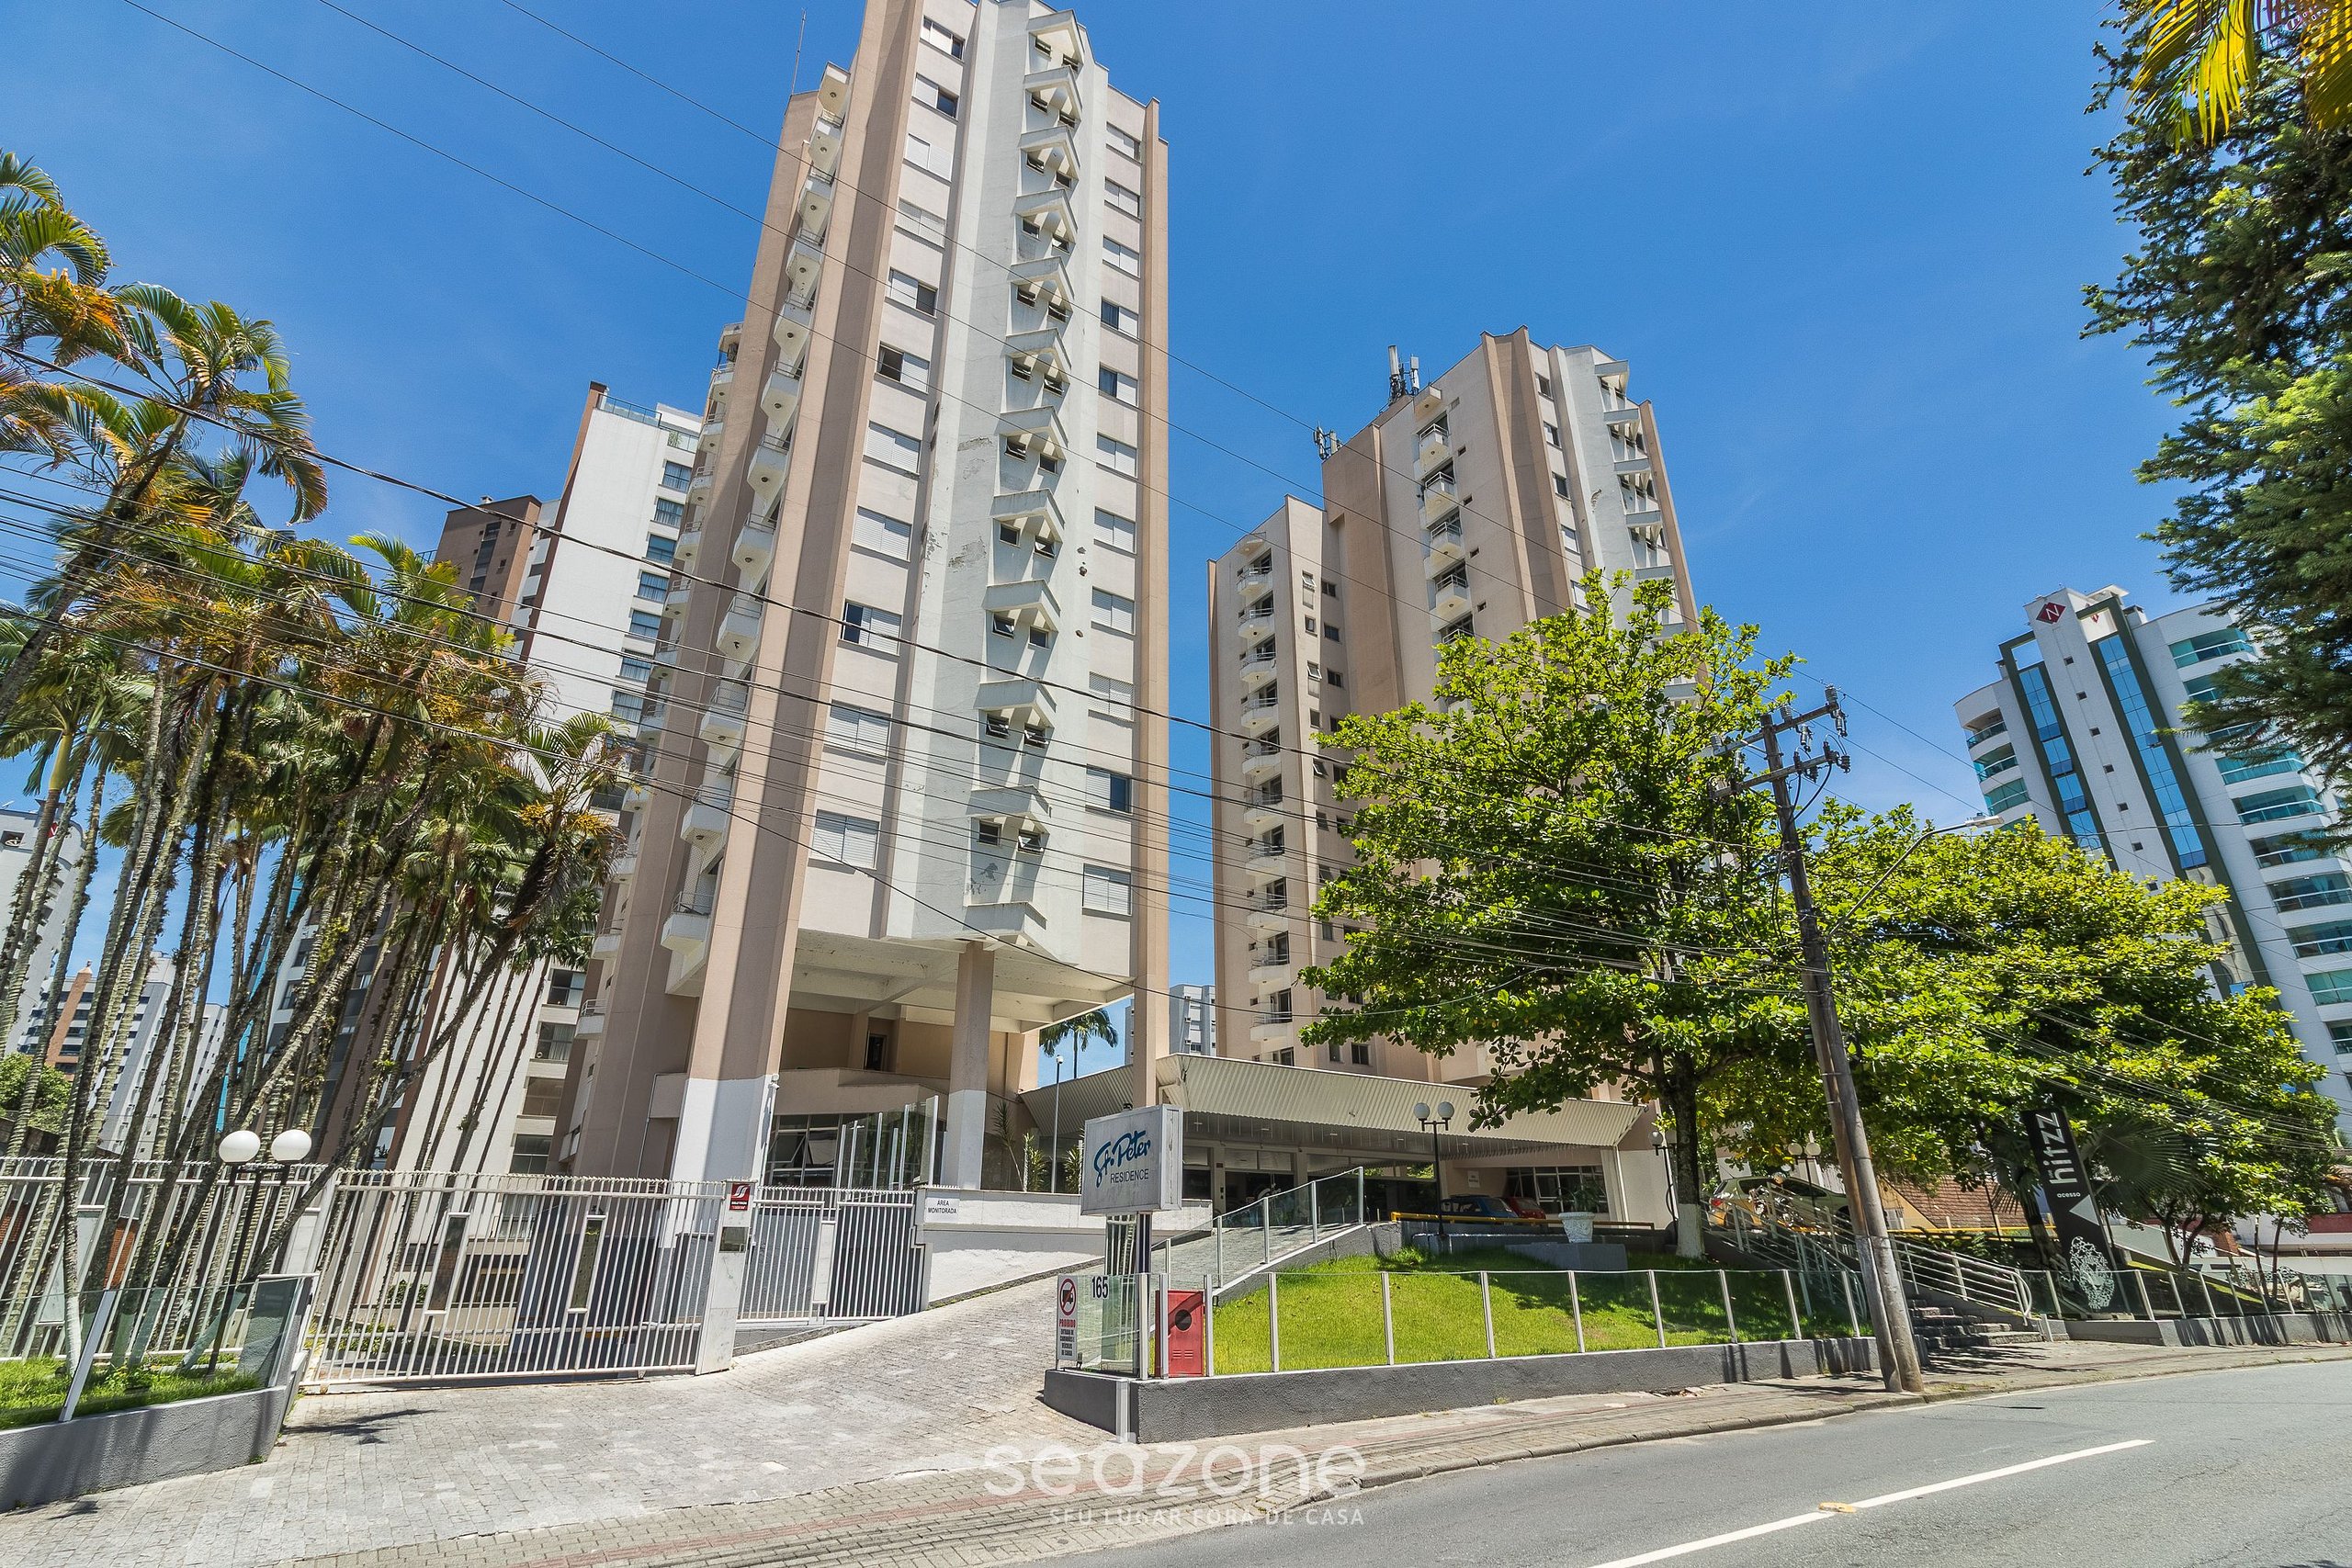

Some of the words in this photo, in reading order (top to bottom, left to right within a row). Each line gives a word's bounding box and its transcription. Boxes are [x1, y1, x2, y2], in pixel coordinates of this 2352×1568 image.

[1113, 1130, 1151, 1168] Peter
[1110, 1168, 1149, 1184] RESIDENCE
[1091, 1276, 1109, 1299] 165
[1059, 1318, 1076, 1327] PROIBIDO
